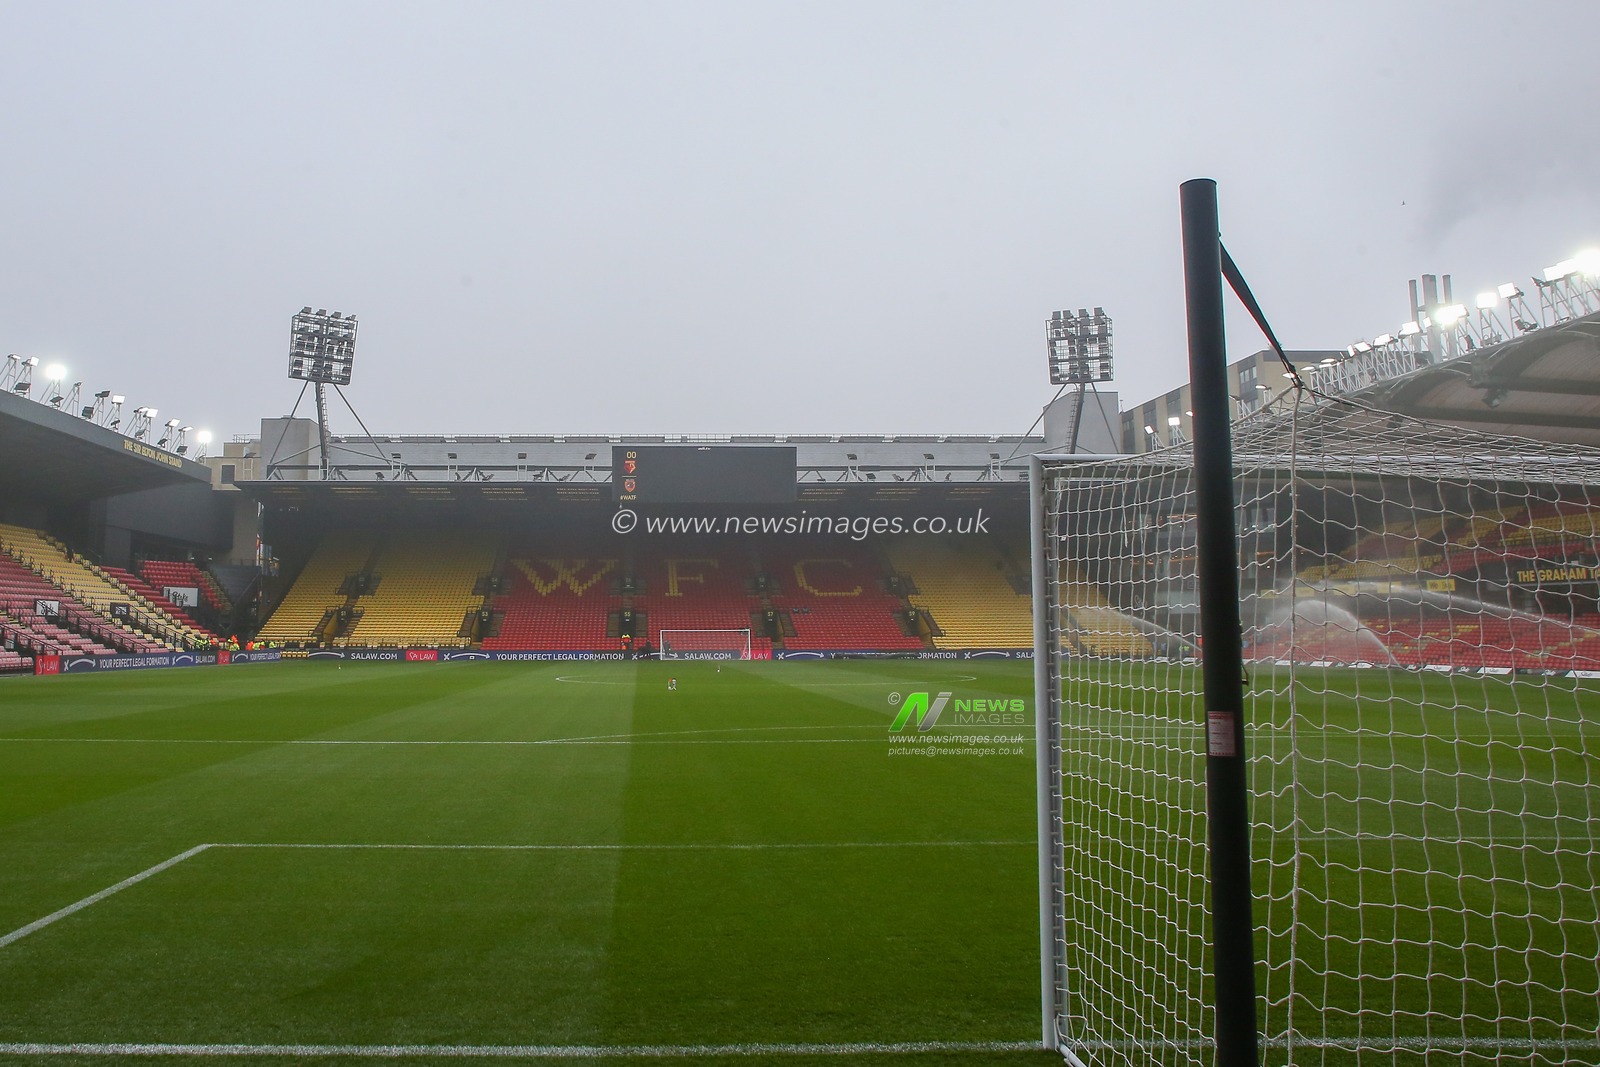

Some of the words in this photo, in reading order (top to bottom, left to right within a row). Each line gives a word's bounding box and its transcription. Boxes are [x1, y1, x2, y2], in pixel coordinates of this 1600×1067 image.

[124, 440, 133, 452] THE
[156, 451, 168, 464] JOHN
[626, 451, 636, 459] 00
[510, 558, 619, 597] W
[664, 558, 719, 597] F
[793, 558, 863, 597] C
[1517, 570, 1536, 582] THE
[1538, 568, 1587, 581] GRAHAM
[47, 660, 58, 671] LAW
[100, 659, 113, 669] YOUR
[112, 657, 132, 668] PERFECT
[133, 657, 146, 667] LEGAL
[146, 656, 169, 666] FORMATION
